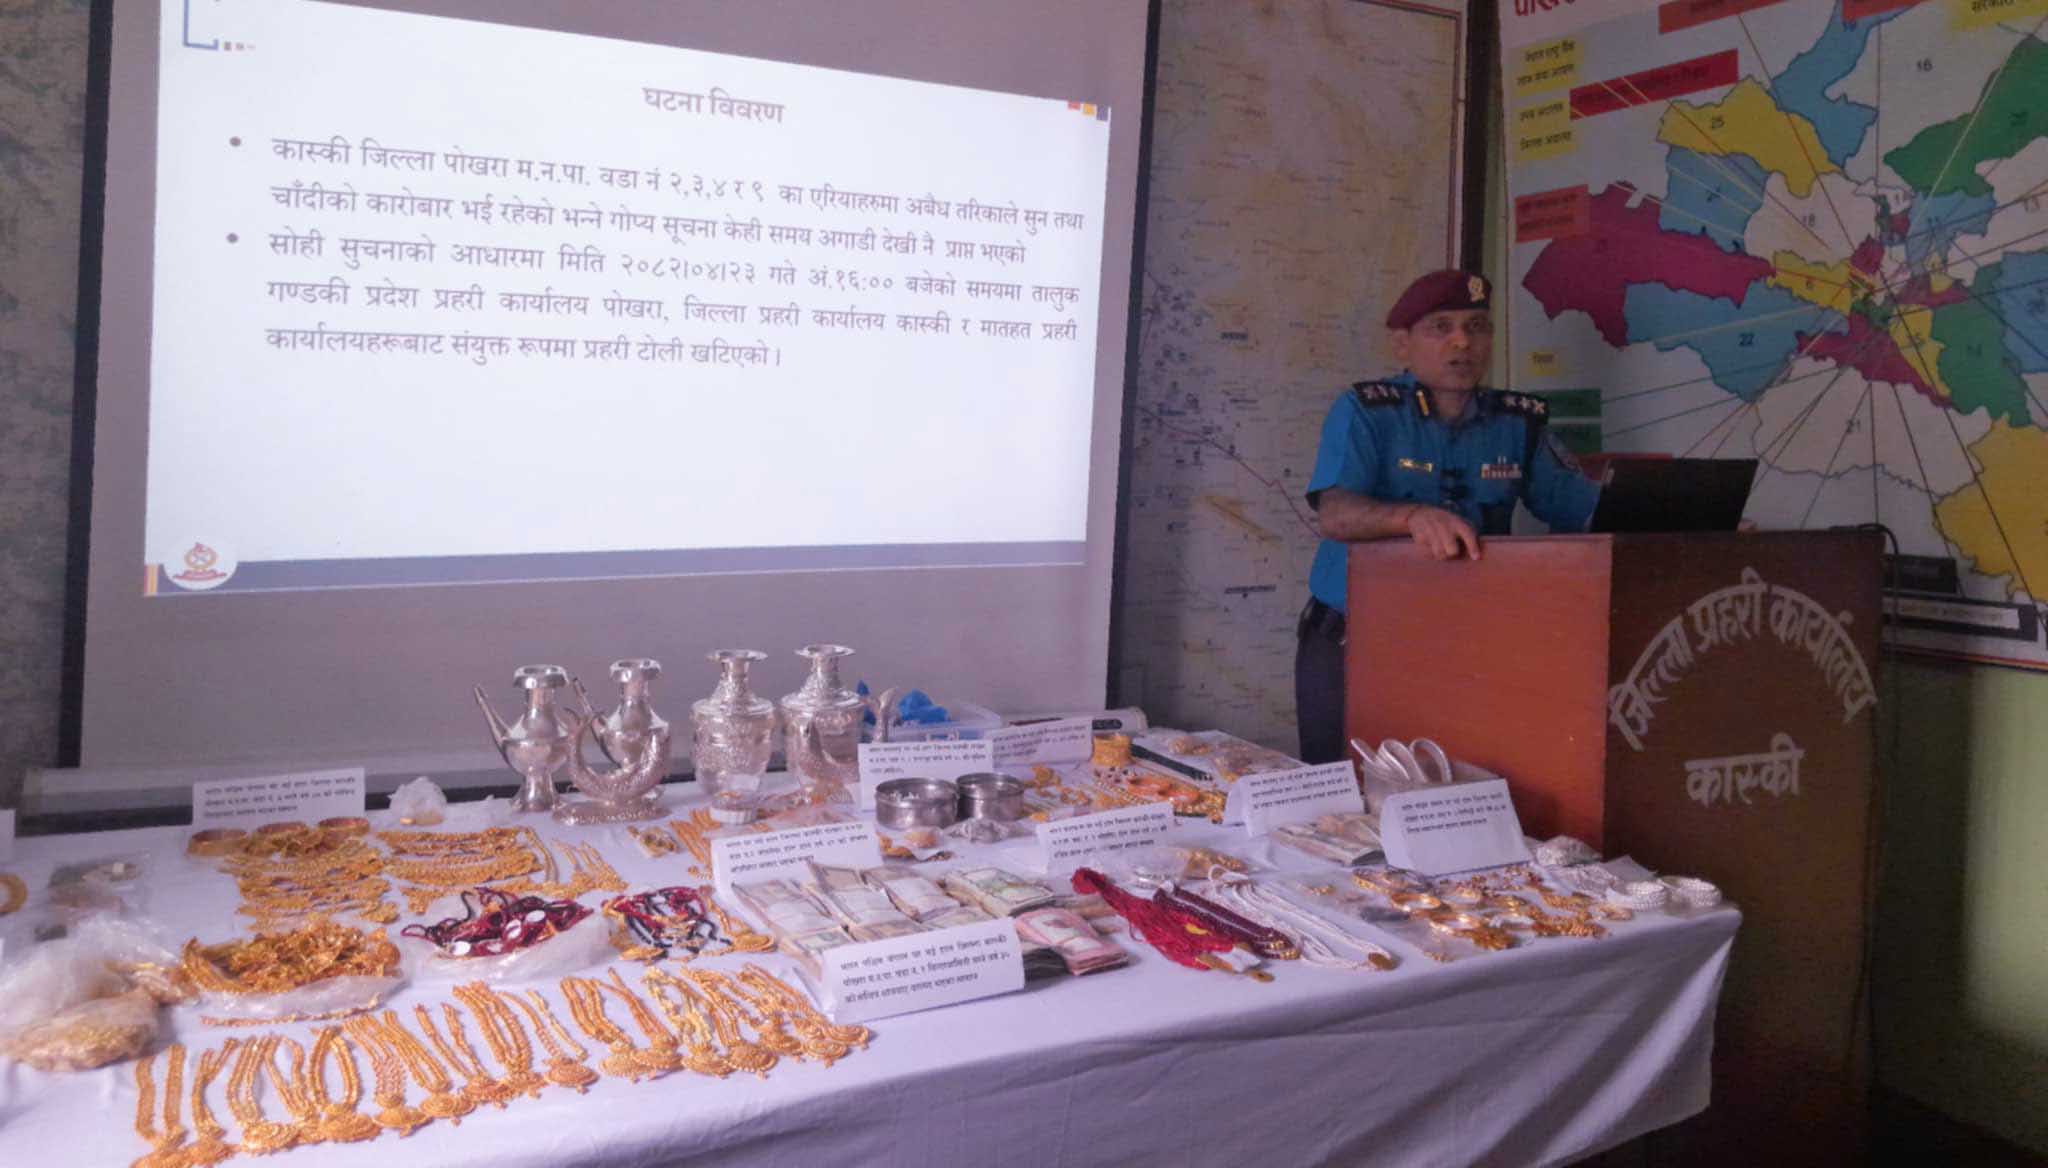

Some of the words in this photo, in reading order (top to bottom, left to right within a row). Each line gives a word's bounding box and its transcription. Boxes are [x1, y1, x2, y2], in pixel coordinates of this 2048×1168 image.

[1916, 59, 1933, 71] 16
[642, 86, 703, 113] घटना
[708, 88, 785, 123] विवरण
[272, 135, 352, 164] कास्की
[360, 137, 436, 171] जिल्ला
[443, 145, 510, 178] पोखरा
[514, 160, 590, 186] म.न.पा.
[598, 168, 640, 189] वडा
[778, 185, 804, 205] का
[955, 197, 1019, 224] तरिकाले
[1024, 209, 1048, 236] सुन
[1053, 212, 1085, 230] तथा
[270, 179, 360, 212] चाँदीको
[365, 186, 455, 219] कारोबार
[461, 193, 494, 225] भई
[499, 195, 556, 225] रहेको
[562, 201, 604, 229] भन्ने
[609, 204, 657, 233] गोप्य
[662, 216, 718, 246] सूचना
[723, 213, 763, 242] केही
[768, 225, 813, 246] समय
[817, 227, 877, 251] अगाडी
[882, 227, 917, 254] देखी
[922, 233, 935, 256] नै
[945, 240, 976, 262] प्राप्त
[981, 240, 1027, 266] भएको
[269, 225, 326, 258] सोही
[339, 234, 437, 270] सुचनाको
[450, 244, 545, 270] आधारमा
[557, 243, 607, 272] मिति
[768, 259, 797, 285] गते
[905, 269, 957, 296] बजेको
[965, 280, 1023, 301] समयमा
[1032, 285, 1080, 312] तालुक
[267, 276, 351, 304] गण्डकी
[364, 277, 420, 308] प्रदेश
[432, 283, 485, 312] प्रहरी
[498, 286, 590, 315] कार्यालय
[602, 289, 669, 322] पोखरा,
[683, 294, 748, 323] जिल्ला
[758, 302, 802, 327] प्रहरी
[812, 304, 887, 330] कार्यालय
[896, 310, 952, 336] कास्की
[961, 318, 971, 335] र
[980, 320, 1032, 340] मातहत
[1041, 318, 1077, 340] प्रहरी
[1739, 333, 1755, 348] 22
[450, 329, 512, 366] संयुक्त
[584, 334, 630, 361] प्रहरी
[636, 334, 684, 362] टोली
[1608, 616, 1695, 752] जिल्ला
[1687, 566, 1768, 652] प्रहरी
[1769, 584, 1878, 724] कार्यालय
[1684, 732, 1806, 808] कास्की
